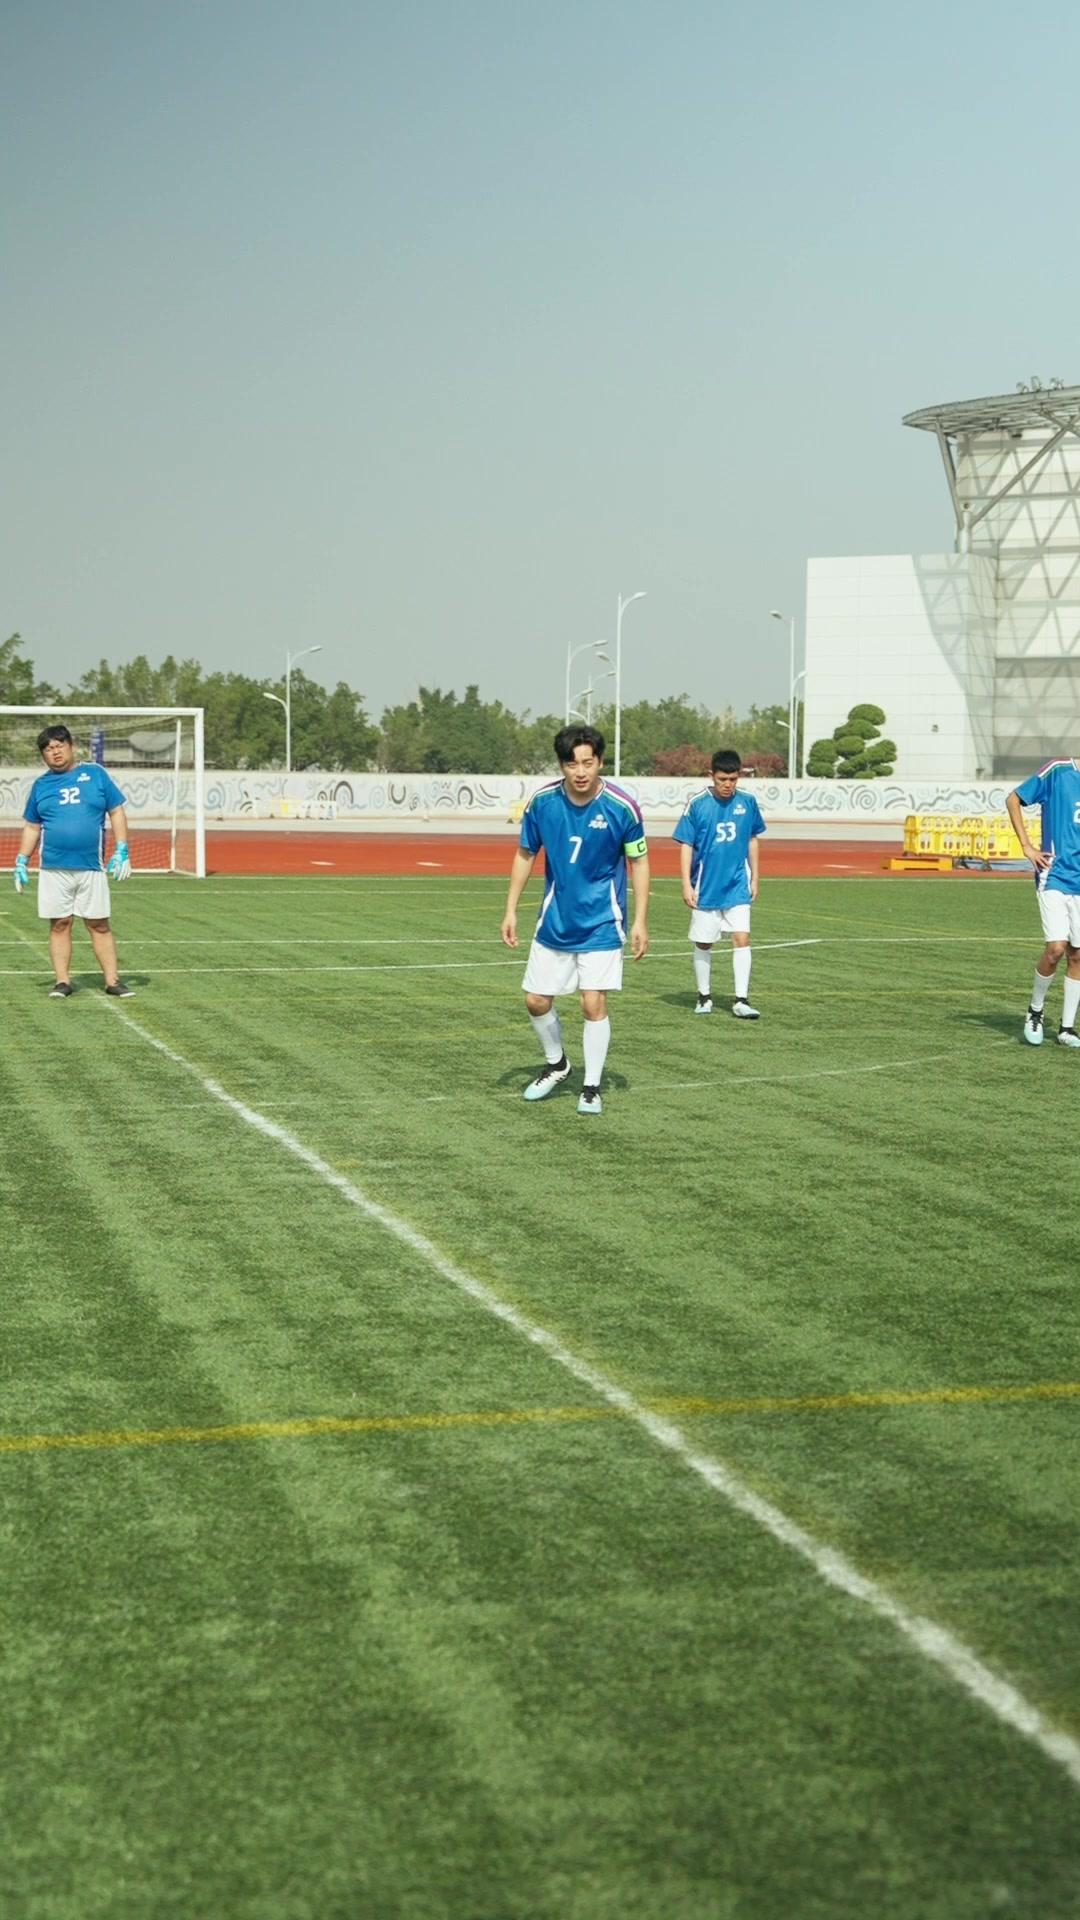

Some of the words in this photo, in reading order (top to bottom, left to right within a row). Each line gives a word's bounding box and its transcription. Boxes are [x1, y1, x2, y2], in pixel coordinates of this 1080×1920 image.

[59, 787, 80, 805] 32
[716, 821, 736, 842] 53
[569, 836, 582, 863] 7
[637, 840, 646, 853] C
